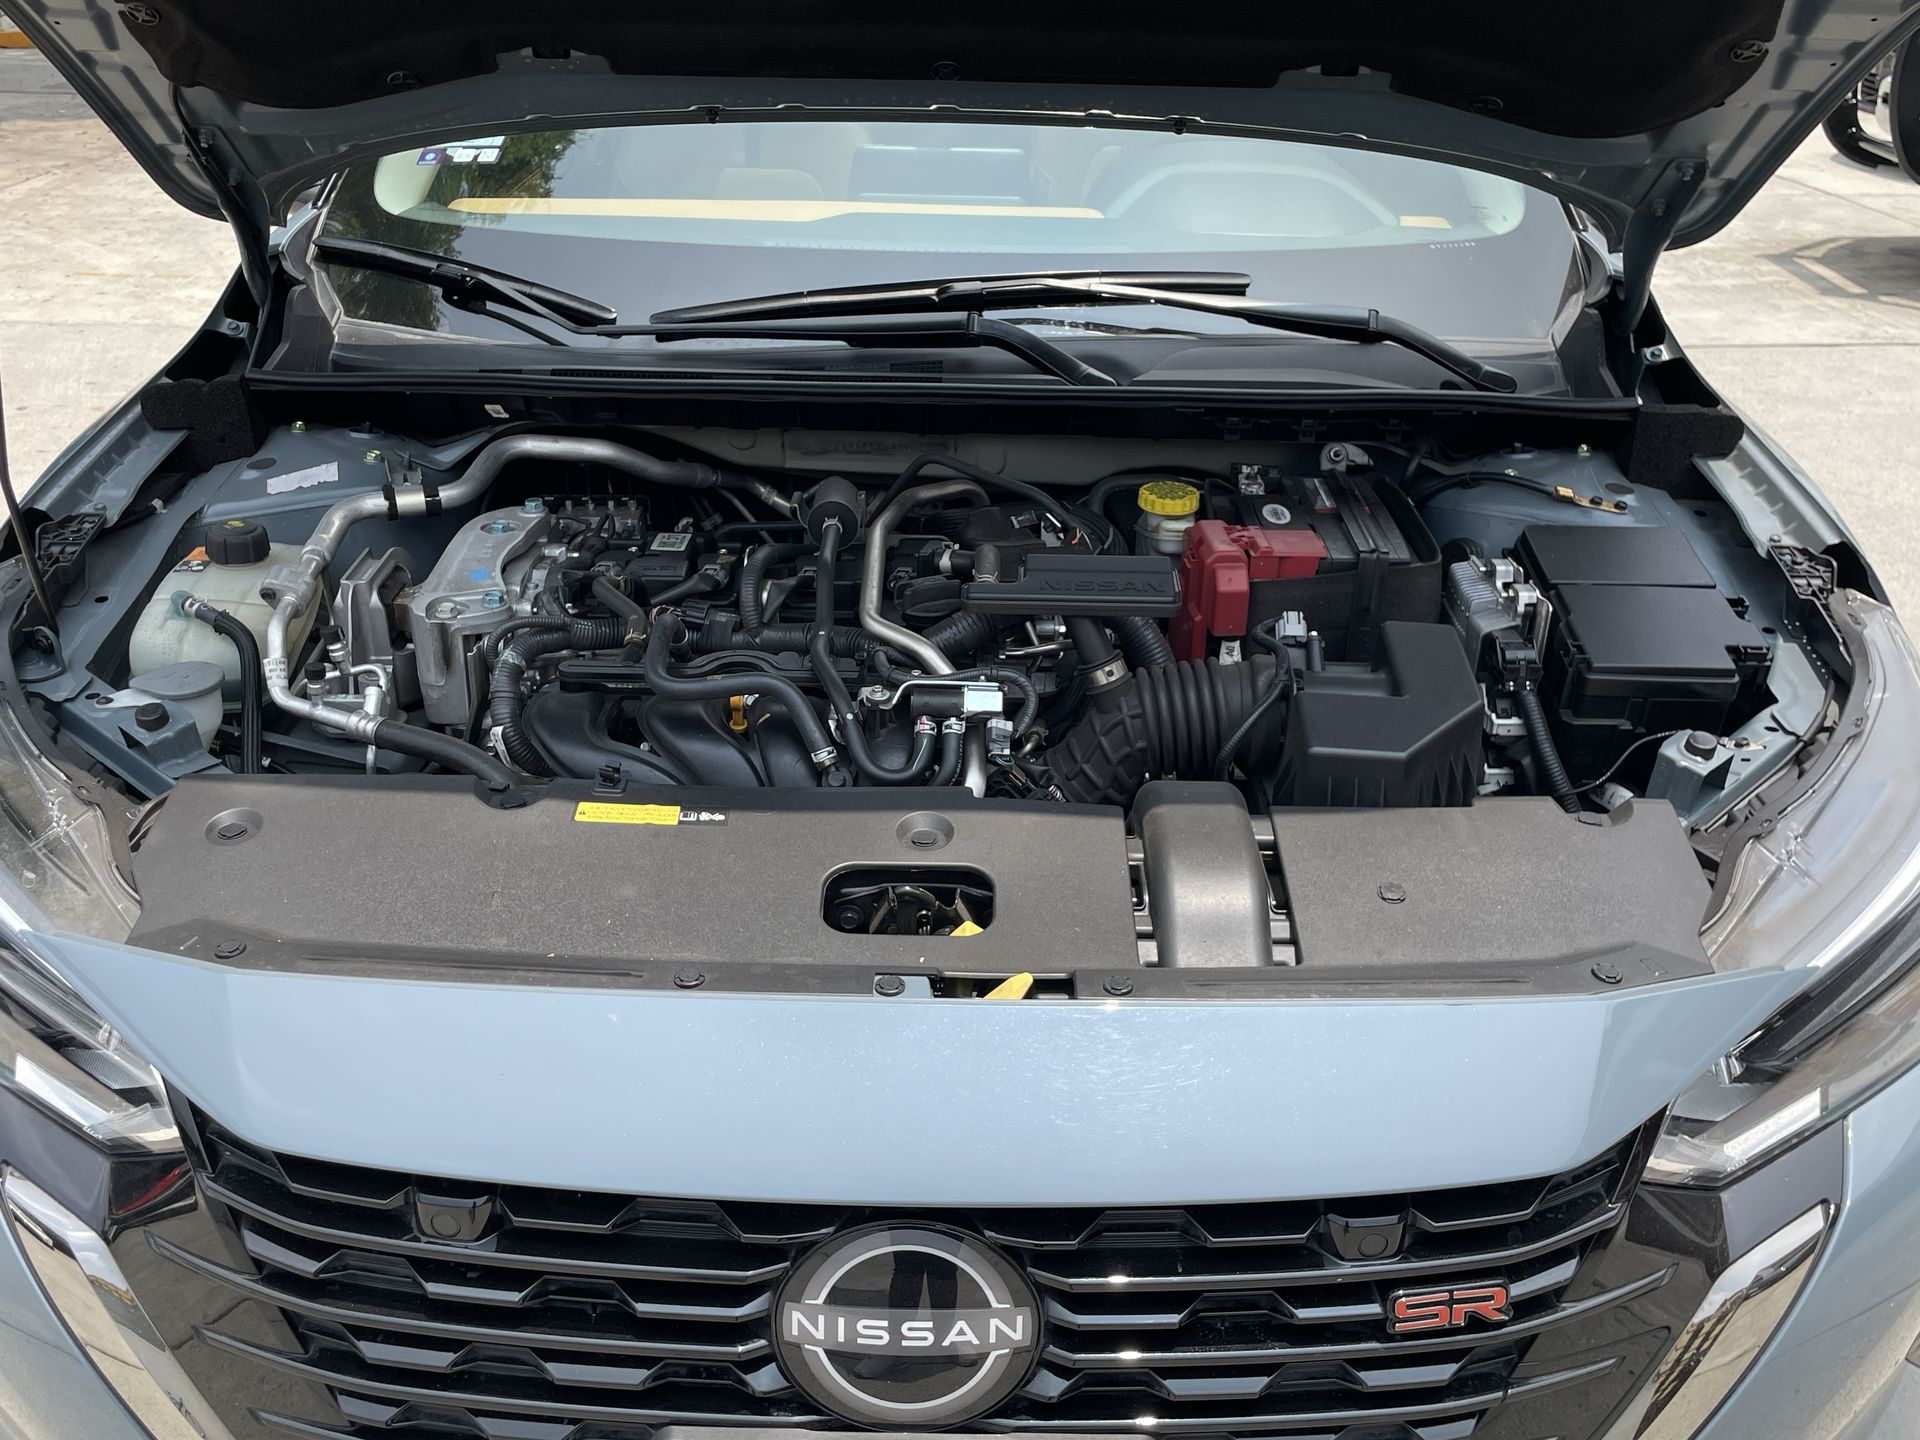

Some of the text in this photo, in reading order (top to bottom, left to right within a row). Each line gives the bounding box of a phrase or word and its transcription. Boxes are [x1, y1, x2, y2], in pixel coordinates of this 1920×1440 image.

[1039, 577, 1166, 593] NISSAN
[1394, 1286, 1508, 1331] SR
[791, 1310, 1023, 1347] NISSAN
